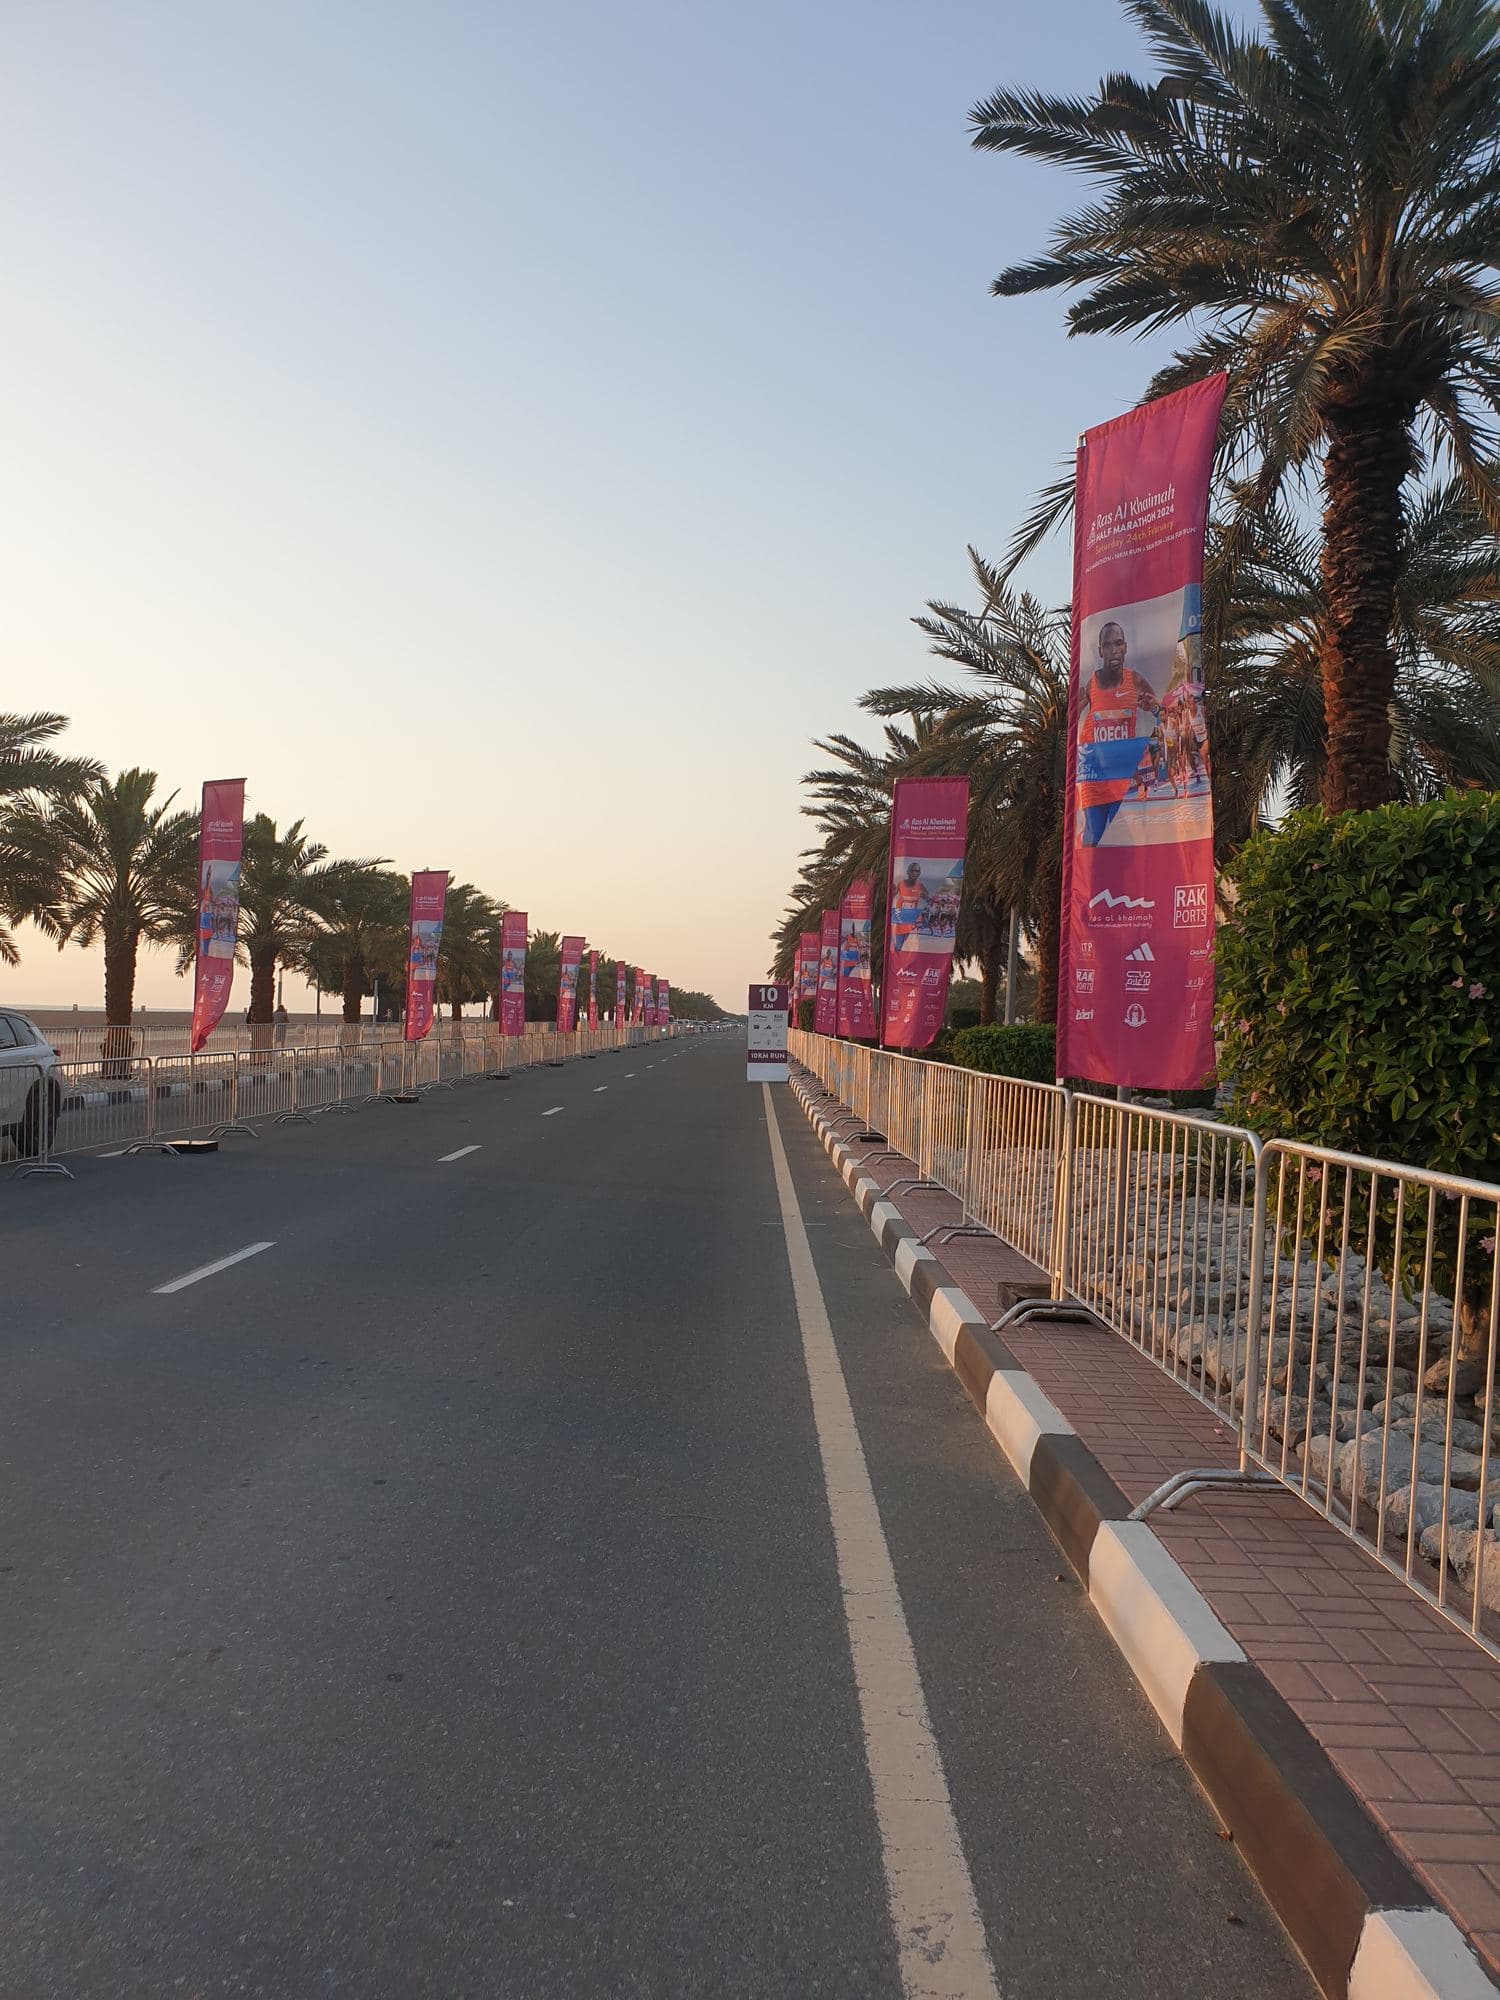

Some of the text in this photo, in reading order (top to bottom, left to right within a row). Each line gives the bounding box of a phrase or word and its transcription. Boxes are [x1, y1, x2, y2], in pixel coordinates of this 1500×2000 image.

[1096, 484, 1175, 529] Ras Al Khaimah
[1096, 504, 1174, 542] HALF MARATHON 2024
[1096, 520, 1174, 554] Saturday 24th February
[1094, 724, 1128, 743] KOECH
[1176, 888, 1205, 908] RAK
[1176, 908, 1206, 923] PORTS
[1076, 972, 1094, 982] RAK
[759, 987, 778, 1002] 10
